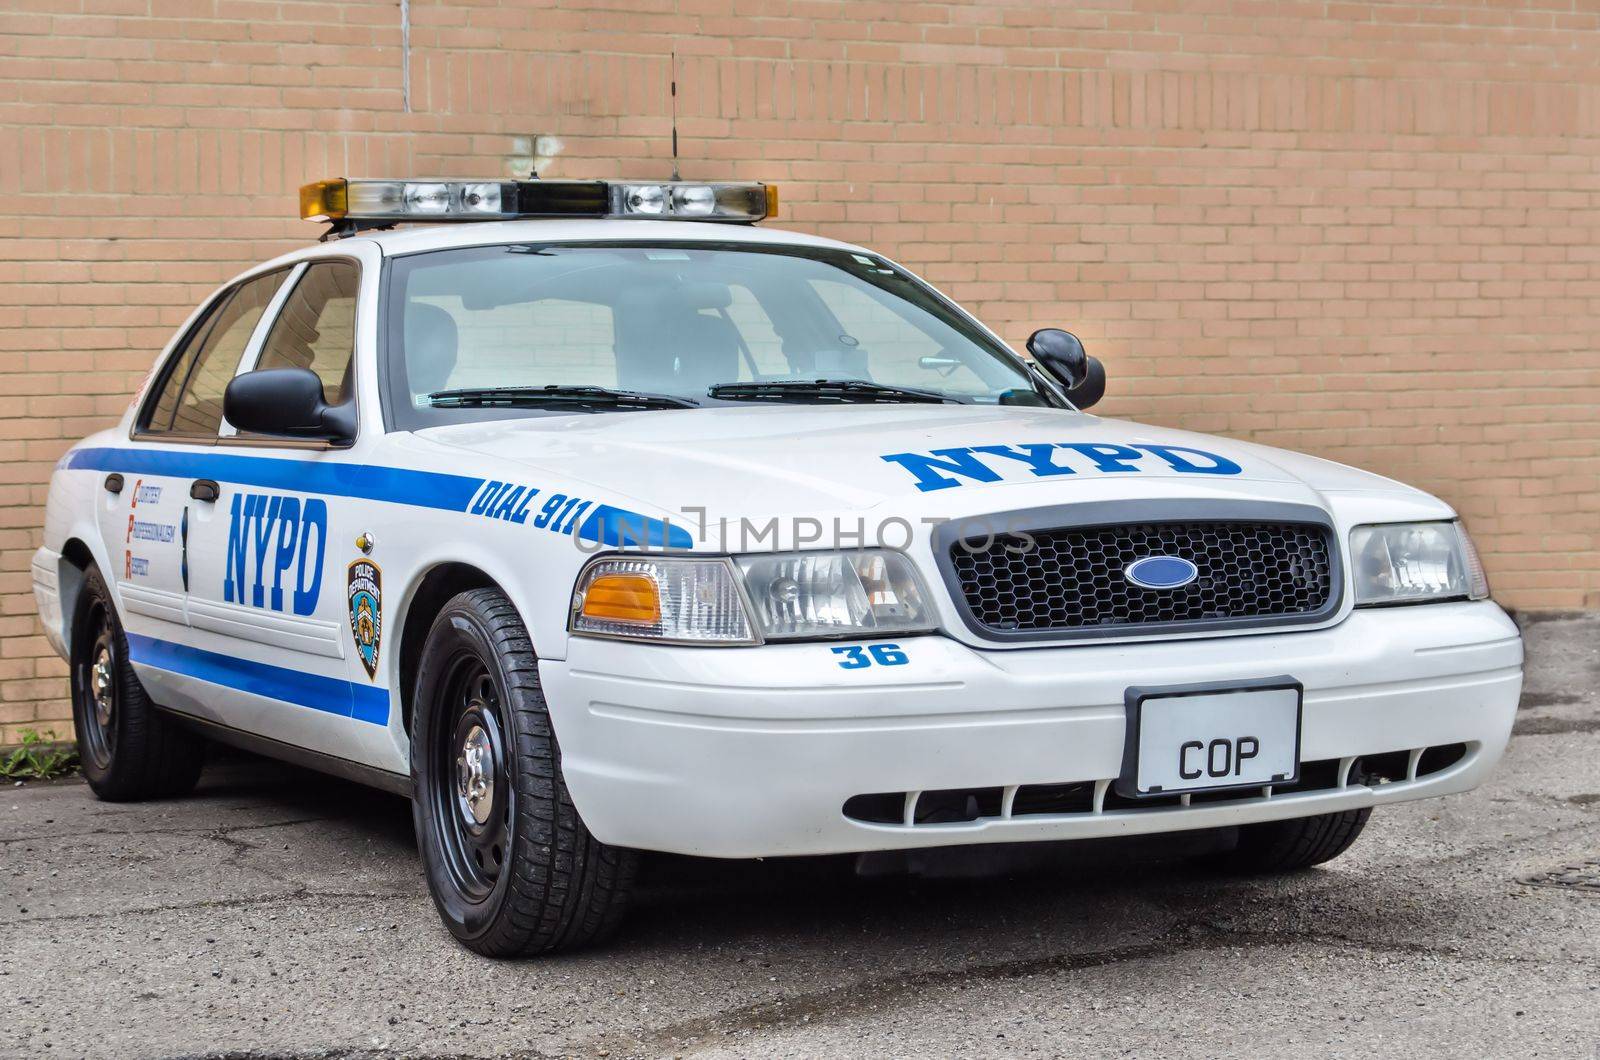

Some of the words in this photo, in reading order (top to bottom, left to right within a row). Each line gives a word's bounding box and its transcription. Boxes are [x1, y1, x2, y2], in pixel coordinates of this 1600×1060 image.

[880, 443, 1243, 492] NYPD
[470, 480, 540, 524] DIAL
[533, 493, 594, 536] 911
[224, 492, 328, 616] NYPD
[354, 563, 375, 581] POLICE
[348, 578, 380, 602] DEPARTMENT
[830, 643, 910, 671] 36
[1178, 735, 1261, 781] COP
